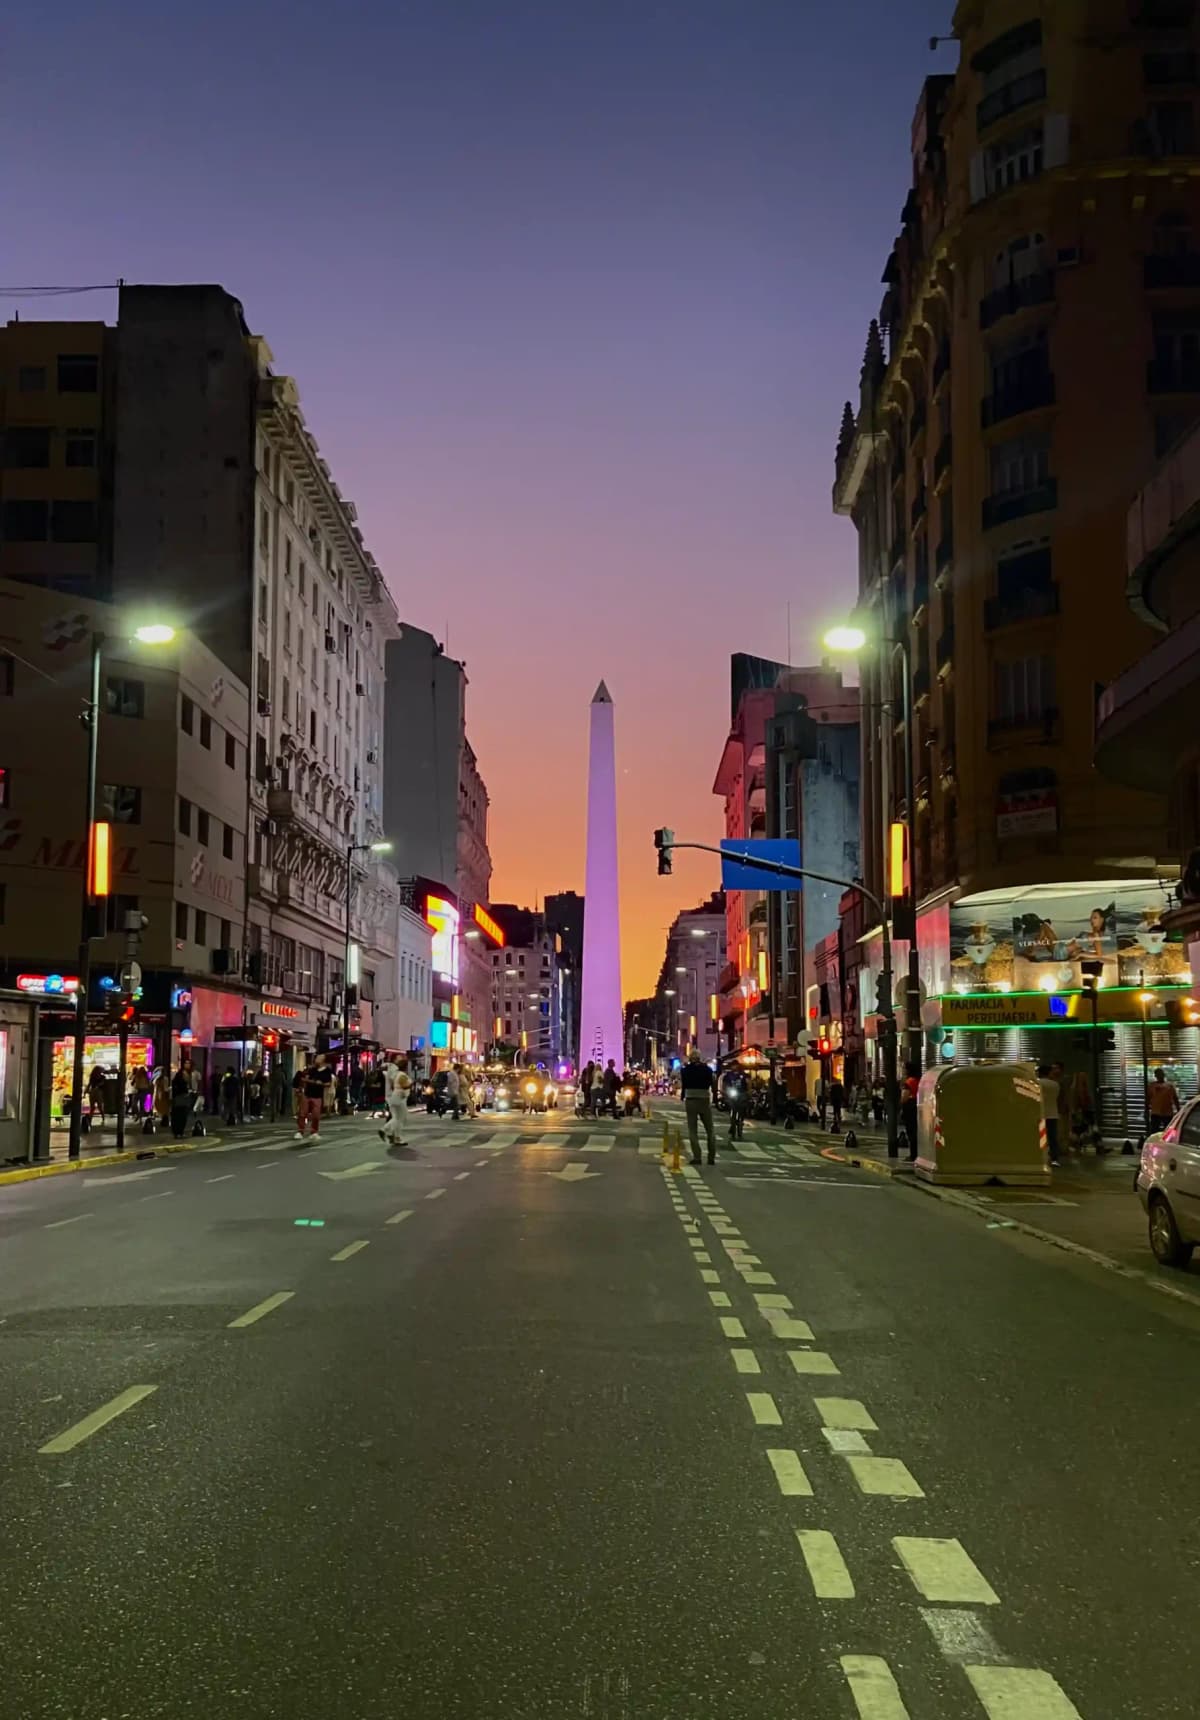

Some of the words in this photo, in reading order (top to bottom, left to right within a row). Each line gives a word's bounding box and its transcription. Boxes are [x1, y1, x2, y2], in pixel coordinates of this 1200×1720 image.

[1018, 938, 1050, 947] VERSACE
[950, 999, 1004, 1010] FARMACIA
[1010, 998, 1018, 1008] Y
[967, 1012, 1037, 1024] PERFUMERIA
